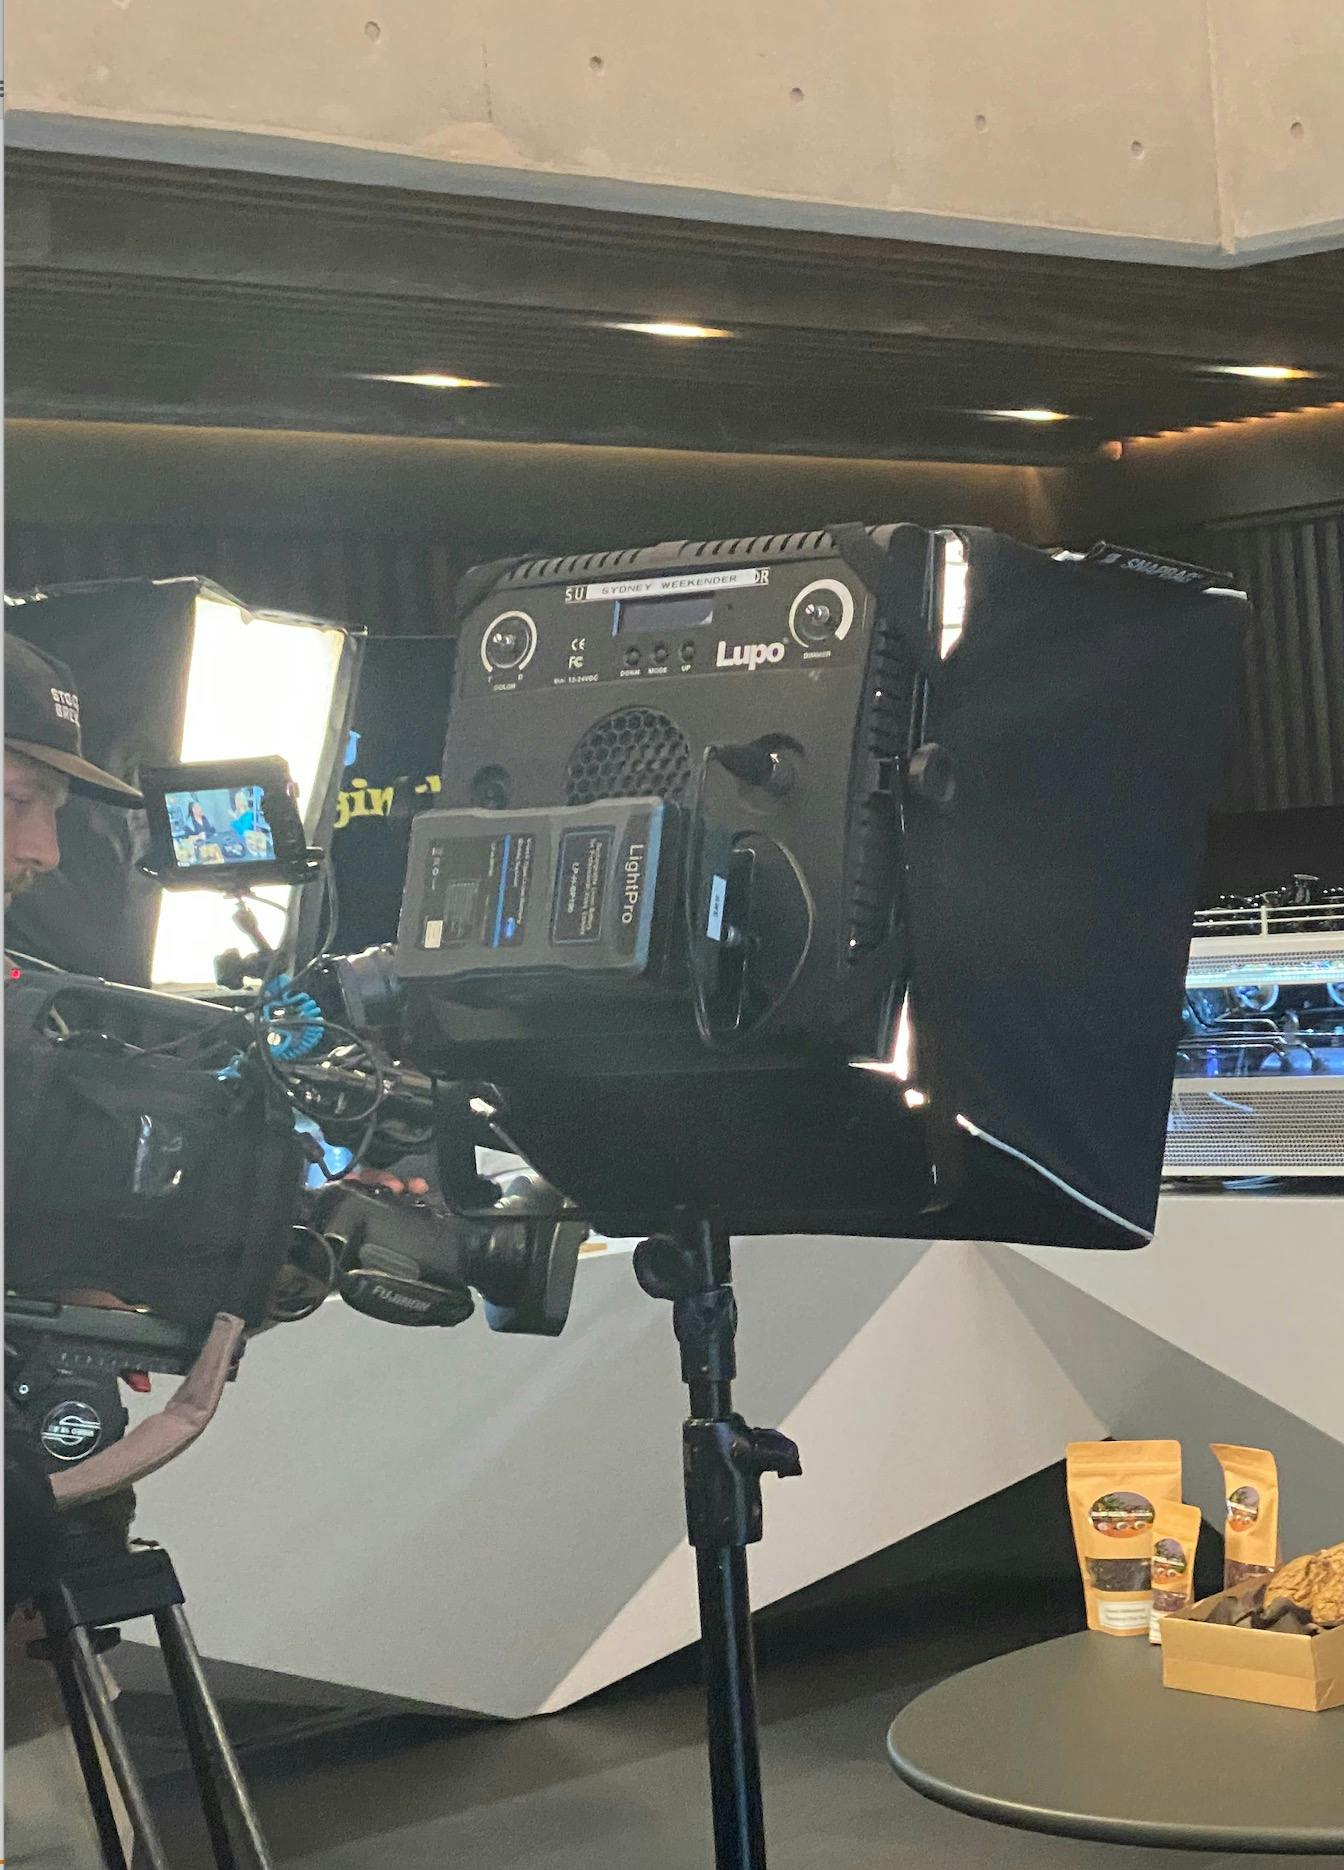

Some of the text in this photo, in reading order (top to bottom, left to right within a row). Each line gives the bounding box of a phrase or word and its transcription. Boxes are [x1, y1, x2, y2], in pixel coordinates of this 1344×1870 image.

[601, 574, 737, 595] SYDNEY WEEKENDER
[716, 640, 785, 671] Lupo
[621, 844, 645, 924] LightPro
